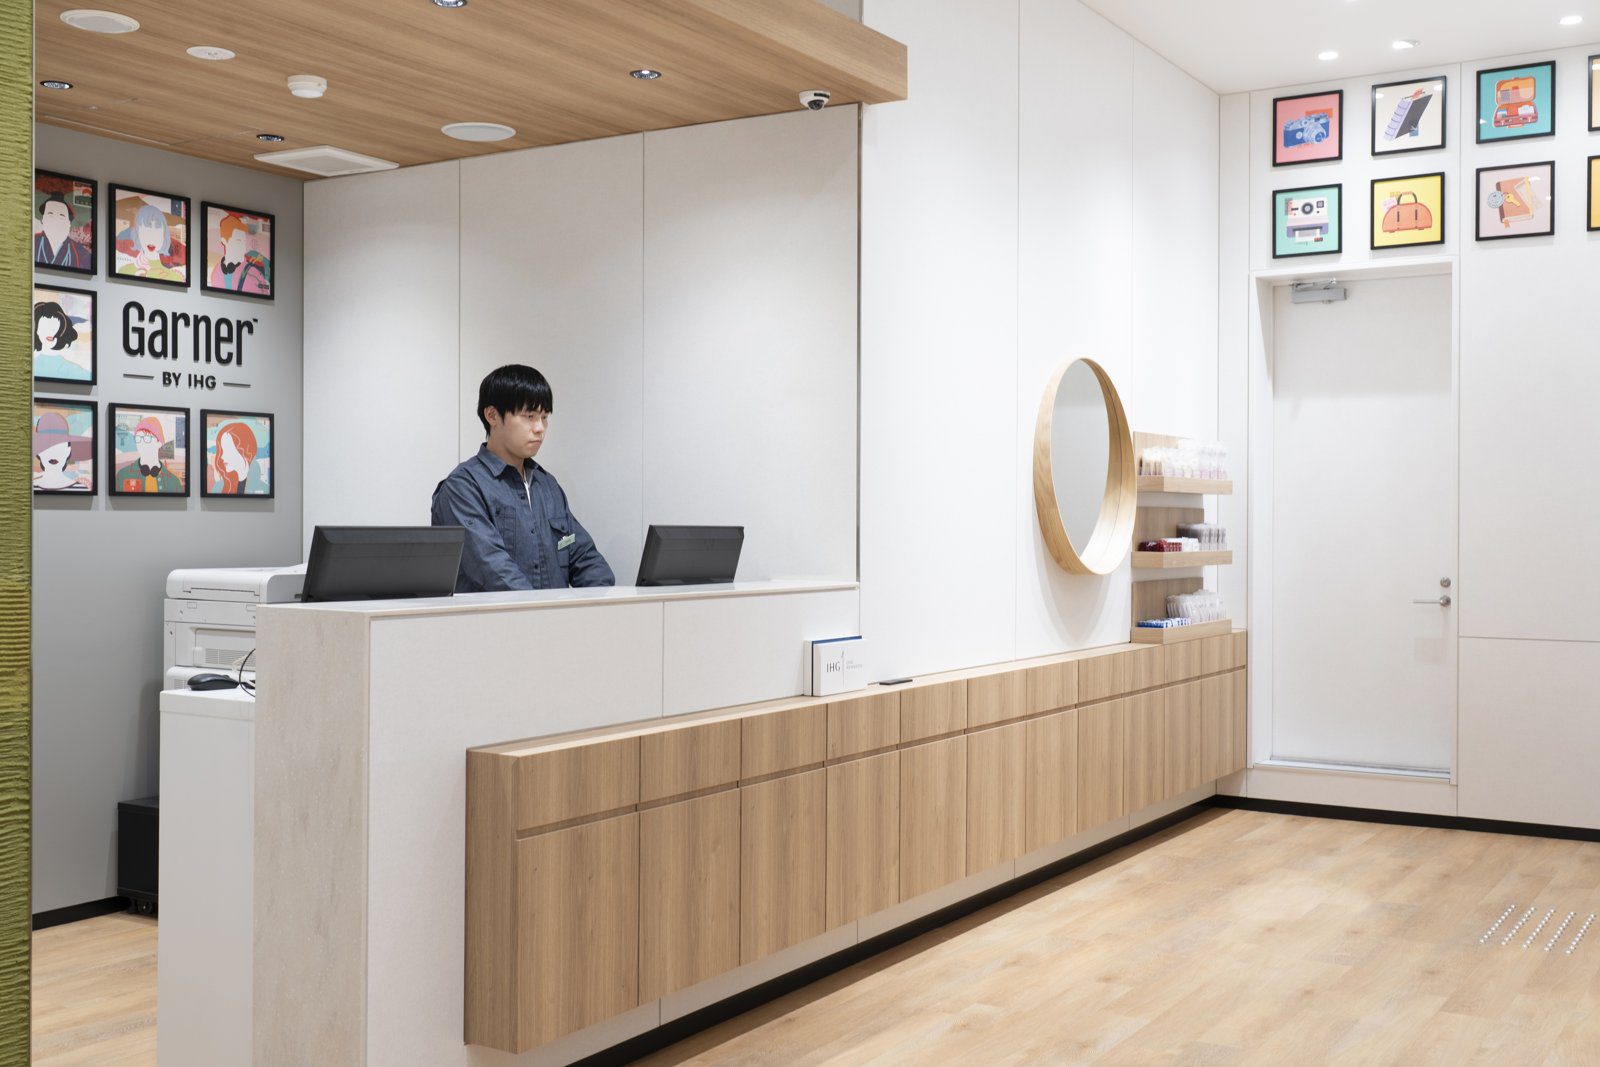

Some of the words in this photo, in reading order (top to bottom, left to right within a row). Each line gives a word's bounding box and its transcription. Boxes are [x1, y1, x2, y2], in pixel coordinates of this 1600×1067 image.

[162, 371, 182, 387] BY
[188, 373, 217, 390] IHG
[826, 661, 841, 673] IHG
